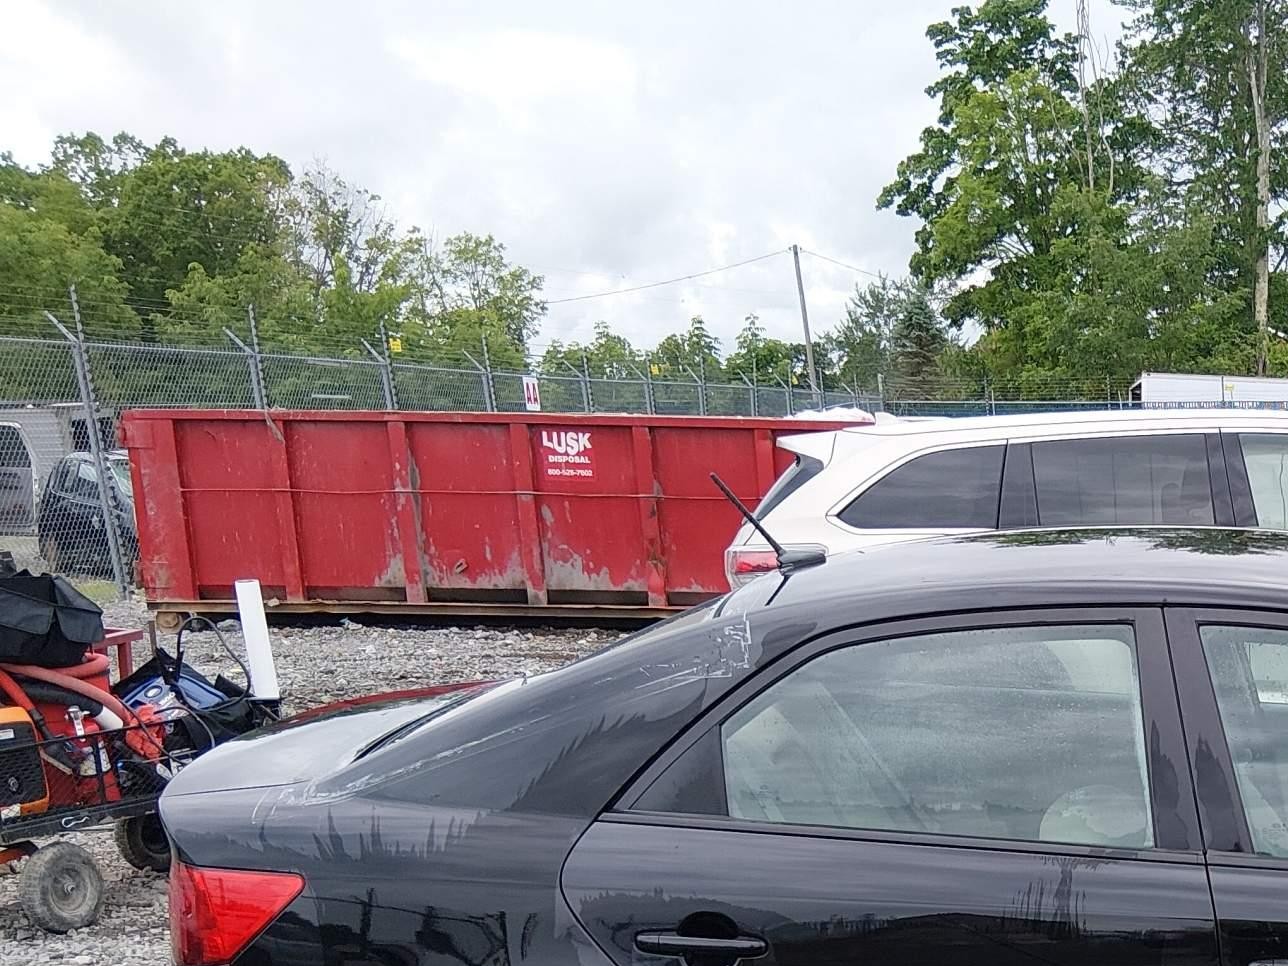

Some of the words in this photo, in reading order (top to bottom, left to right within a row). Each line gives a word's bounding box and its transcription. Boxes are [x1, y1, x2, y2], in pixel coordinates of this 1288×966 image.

[526, 382, 539, 405] AA
[542, 430, 592, 455] LUSK
[548, 455, 591, 464] DISPOSAL
